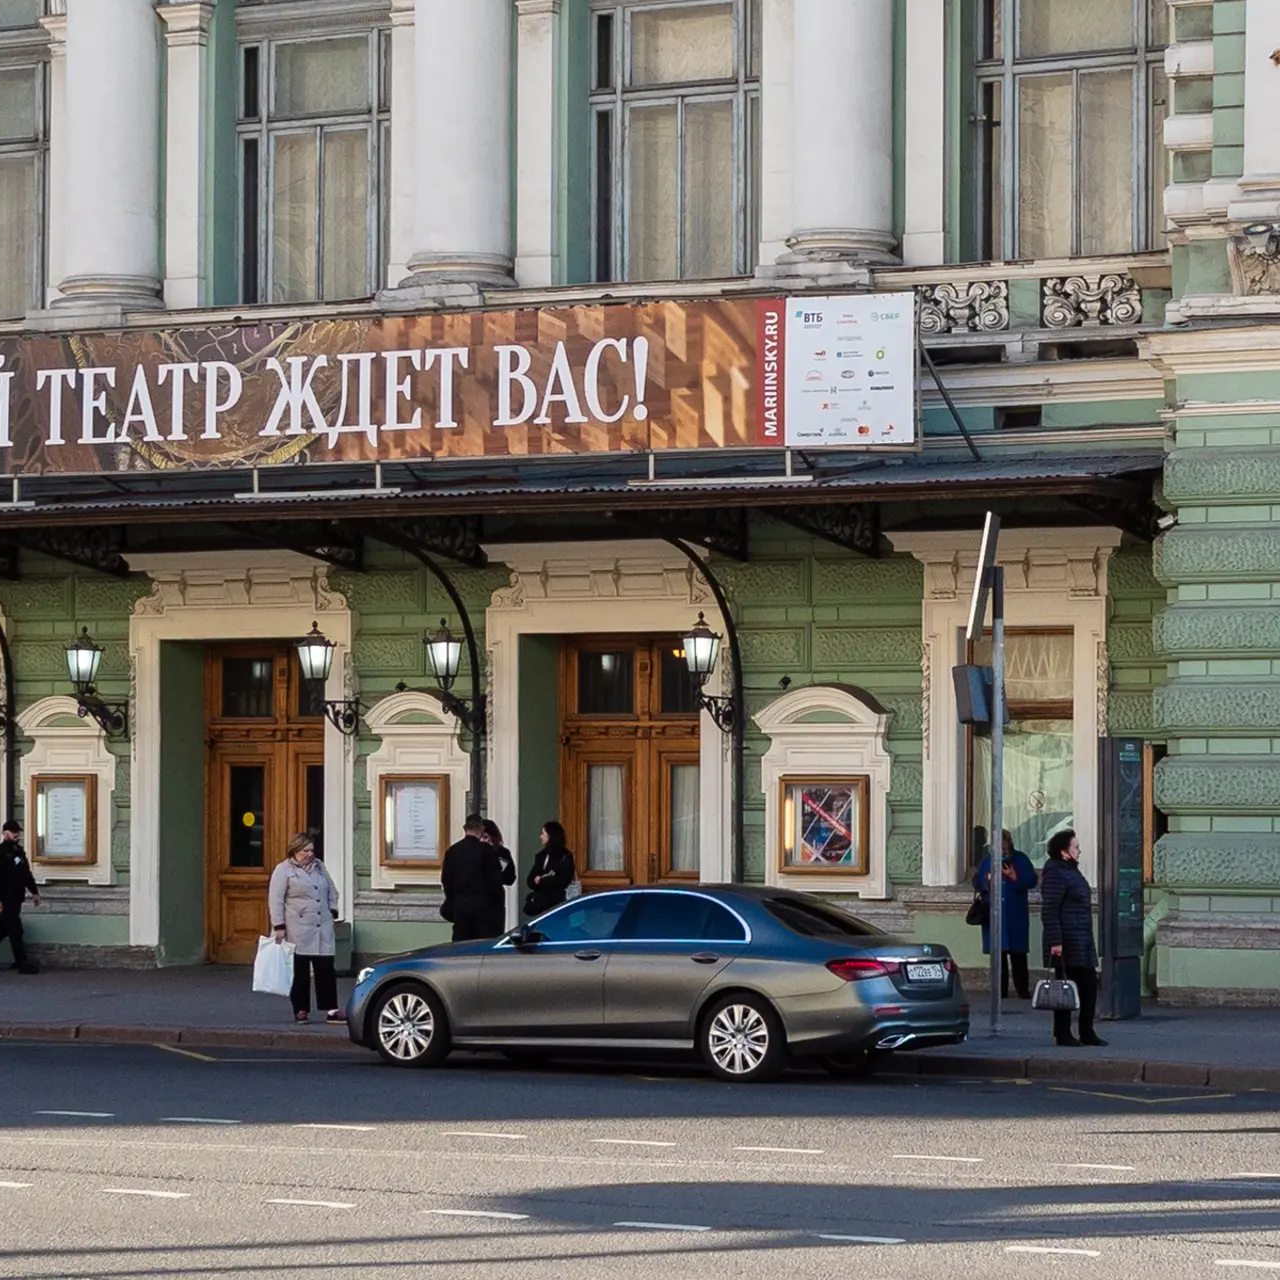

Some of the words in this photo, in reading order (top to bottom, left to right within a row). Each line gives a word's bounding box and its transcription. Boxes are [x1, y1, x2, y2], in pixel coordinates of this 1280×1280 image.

[764, 311, 779, 437] MARIINSKY.RU
[804, 312, 823, 323] ВТБ
[36, 361, 243, 445] ТЕАТР
[258, 347, 469, 450] ЖДЕТ
[493, 336, 650, 427] ВАС!
